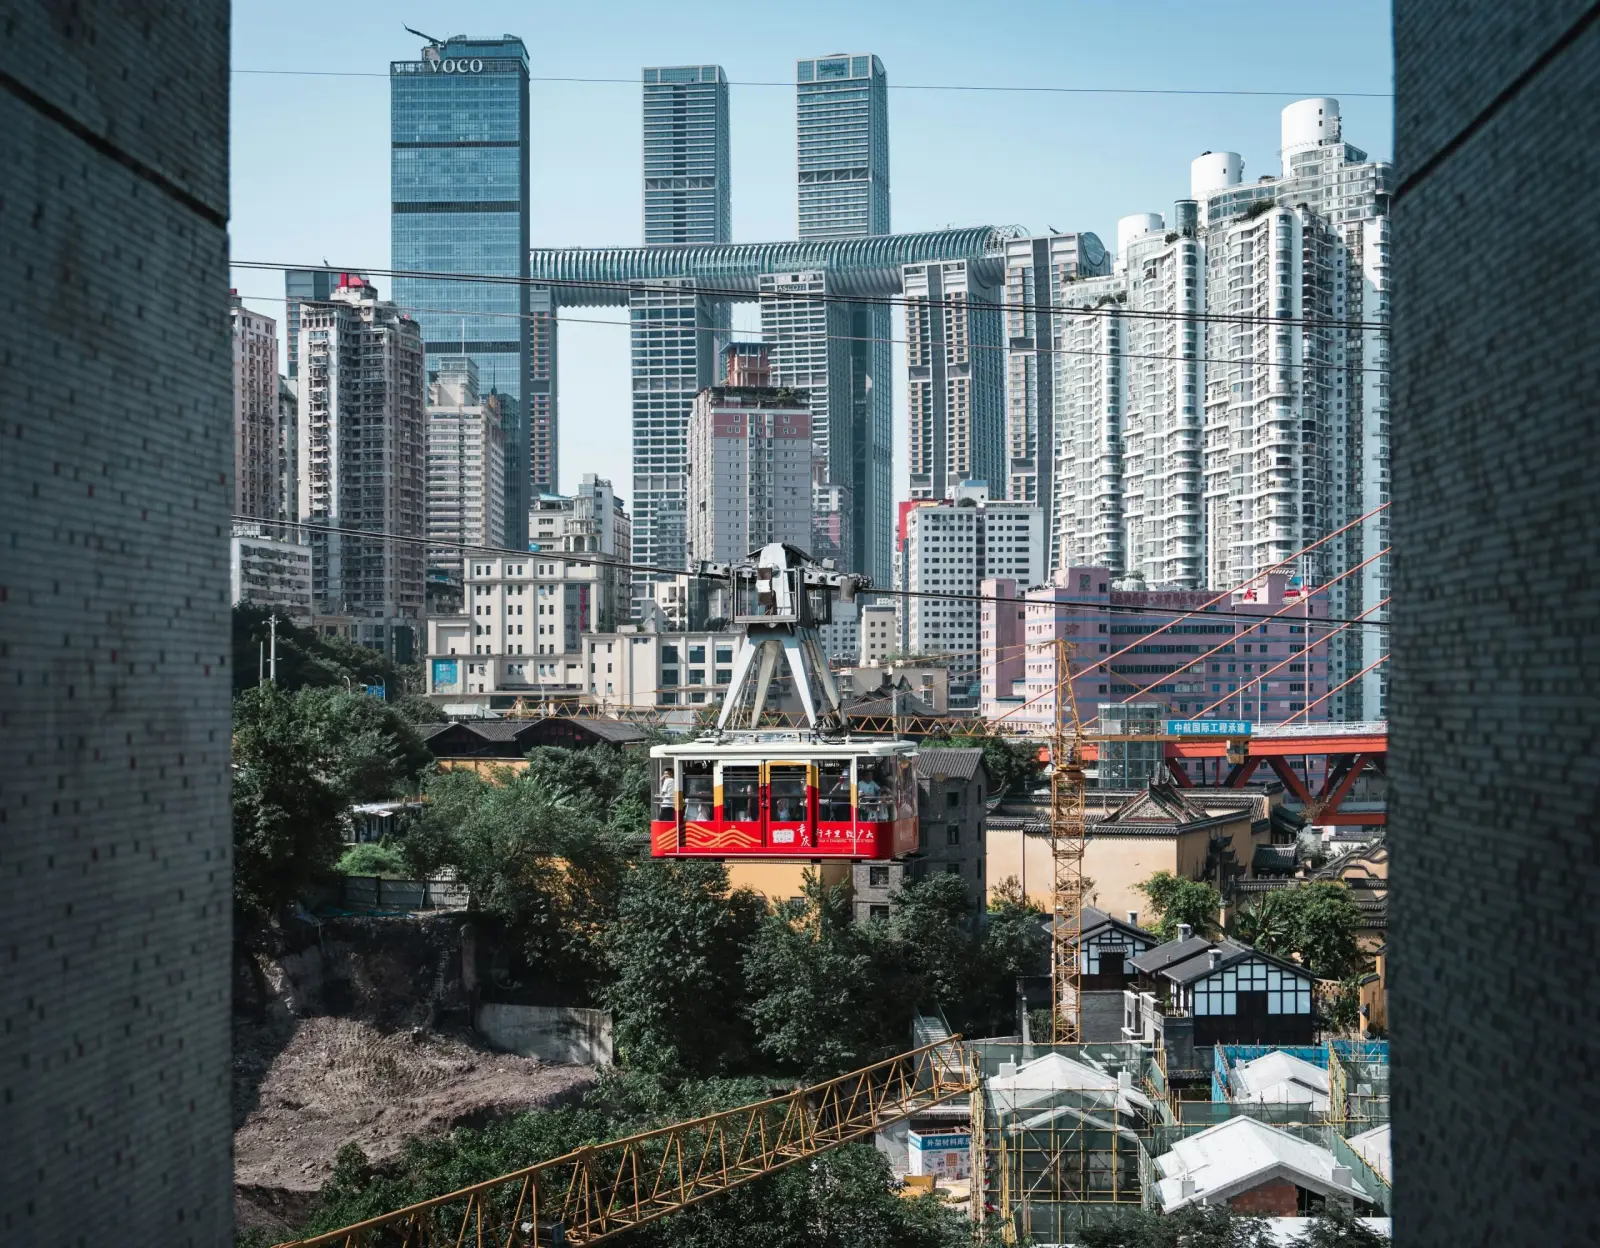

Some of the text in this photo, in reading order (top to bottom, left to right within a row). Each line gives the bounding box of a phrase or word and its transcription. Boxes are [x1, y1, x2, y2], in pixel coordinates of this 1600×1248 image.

[1174, 722, 1246, 734] 中航国际工程承建
[797, 823, 812, 847] 重庆
